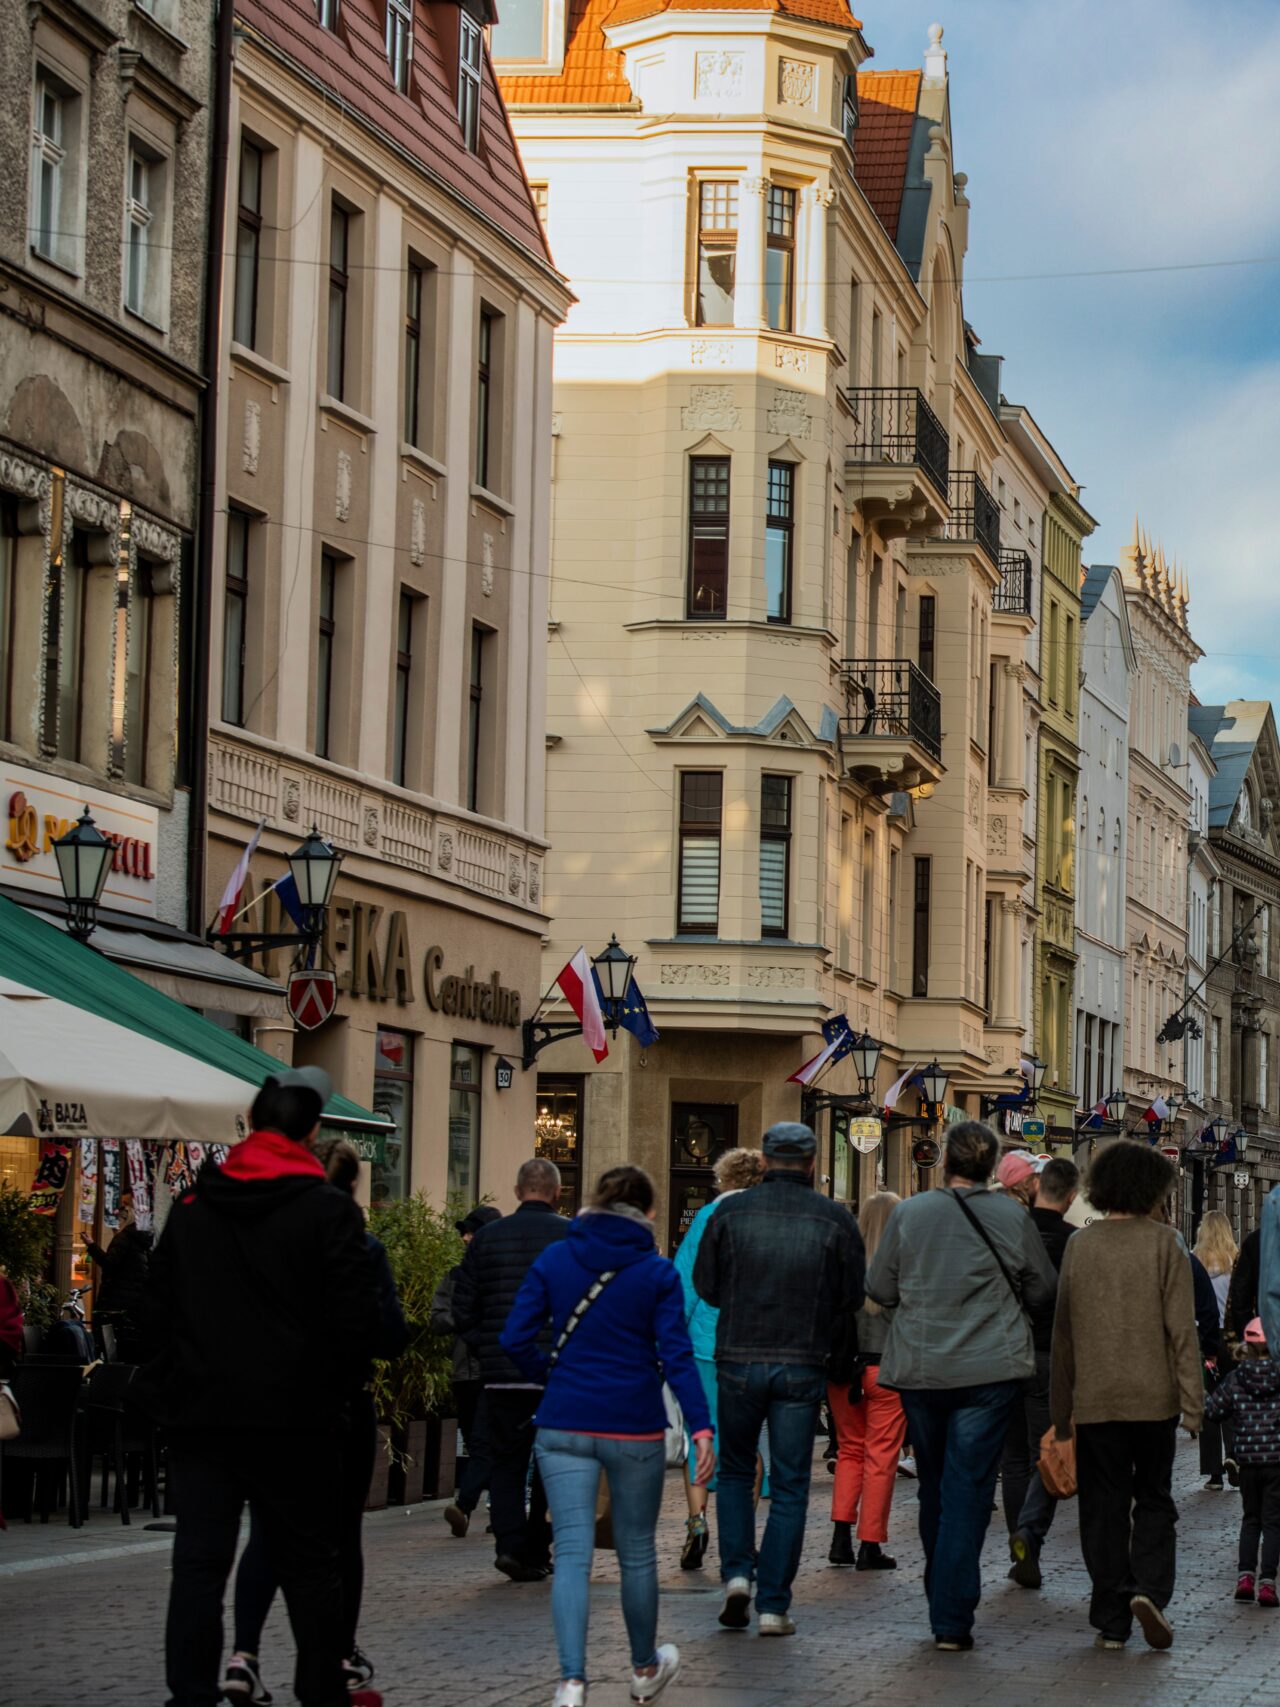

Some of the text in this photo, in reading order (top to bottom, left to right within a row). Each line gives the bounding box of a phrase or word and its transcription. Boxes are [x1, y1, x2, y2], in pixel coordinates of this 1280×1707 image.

[423, 944, 522, 1027] Centralna
[498, 1072, 510, 1084] 30
[55, 1102, 88, 1124] BAZA
